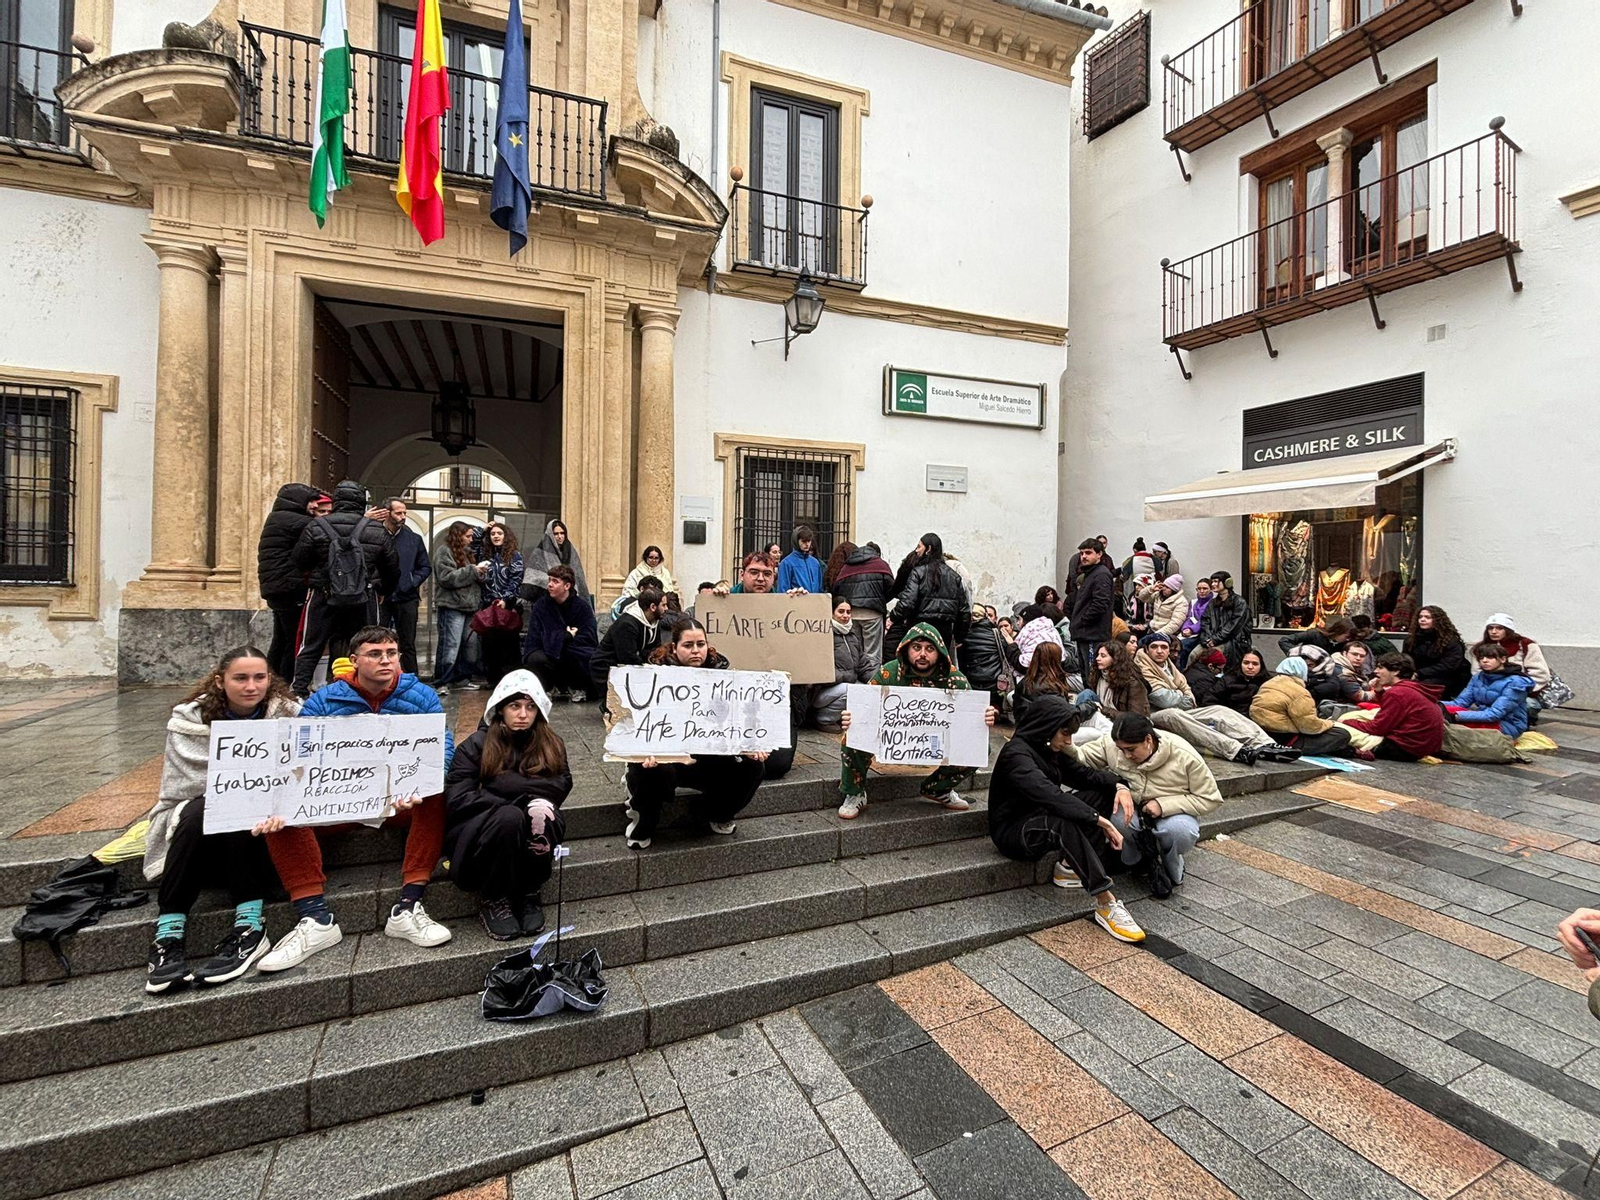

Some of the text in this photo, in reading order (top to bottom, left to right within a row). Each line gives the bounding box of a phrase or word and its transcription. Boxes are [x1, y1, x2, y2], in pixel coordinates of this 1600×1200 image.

[931, 387, 954, 397] Escuela
[955, 389, 980, 400] Superior
[990, 394, 1001, 402] Arte
[1003, 395, 1031, 405] Dramático
[979, 402, 1031, 415] Miguel Salcedo Hierro
[1254, 426, 1406, 462] CASHMERE & SILK
[706, 611, 723, 634] EL
[726, 614, 764, 639] ARTE
[626, 673, 700, 710] Unos
[711, 680, 782, 705] Mínimos
[692, 701, 717, 717] Para
[883, 694, 955, 713] Queremos
[883, 709, 936, 720] soluciones
[635, 710, 768, 742] Arte Dramático
[908, 732, 929, 744] más
[280, 743, 290, 764] y
[301, 741, 320, 754] sin
[325, 739, 374, 757] espacios
[376, 737, 409, 754] dignos
[412, 737, 439, 751] para
[885, 745, 944, 761] Mentiras
[212, 766, 376, 794] trabajar PEDIMOS
[304, 781, 368, 797] REACCIÓN
